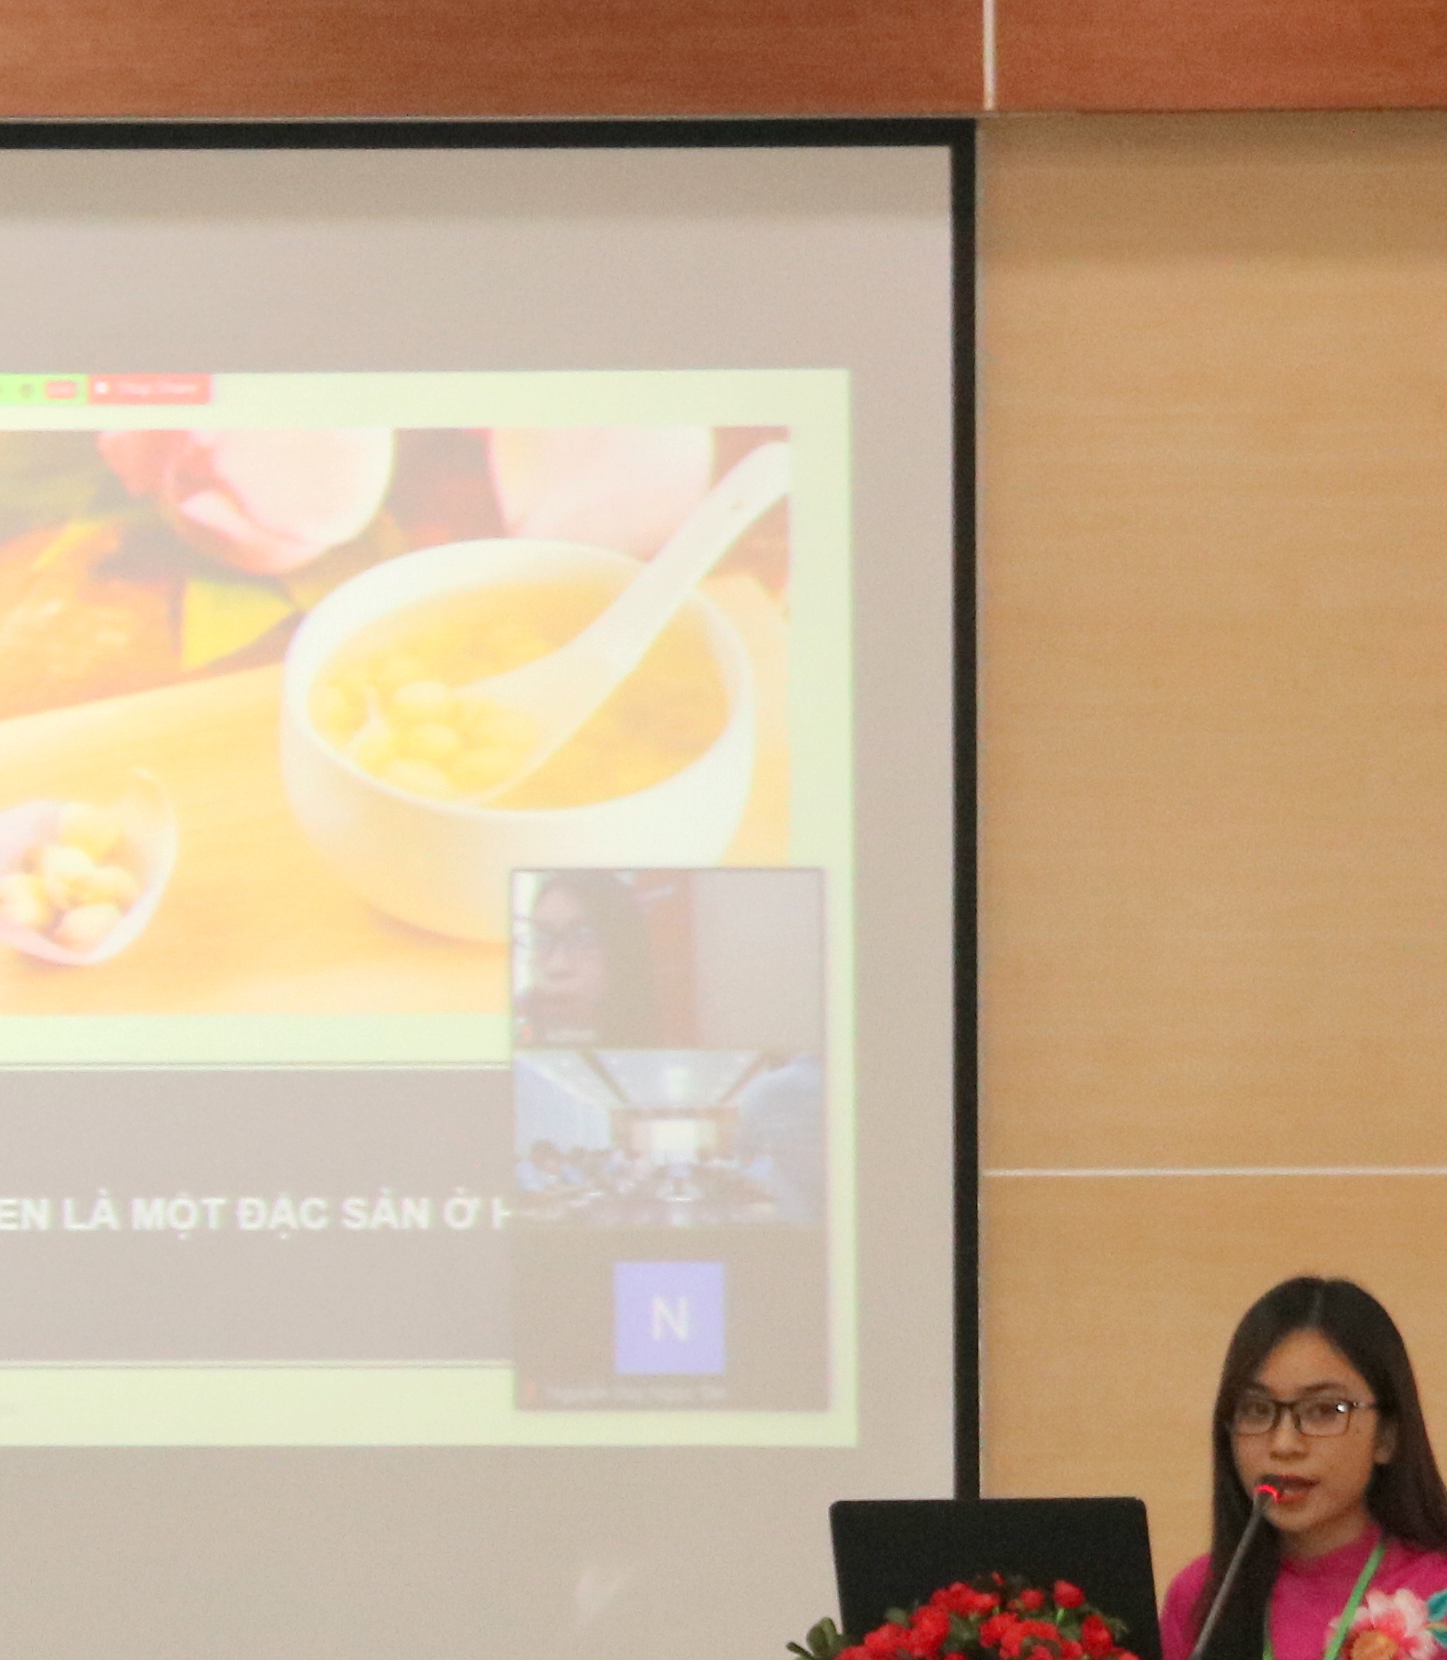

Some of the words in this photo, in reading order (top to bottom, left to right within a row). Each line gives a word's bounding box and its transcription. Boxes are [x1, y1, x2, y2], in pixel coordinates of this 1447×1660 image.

[62, 1188, 121, 1232] LÀ
[132, 1188, 224, 1241] MỘT
[650, 1296, 690, 1342] N
